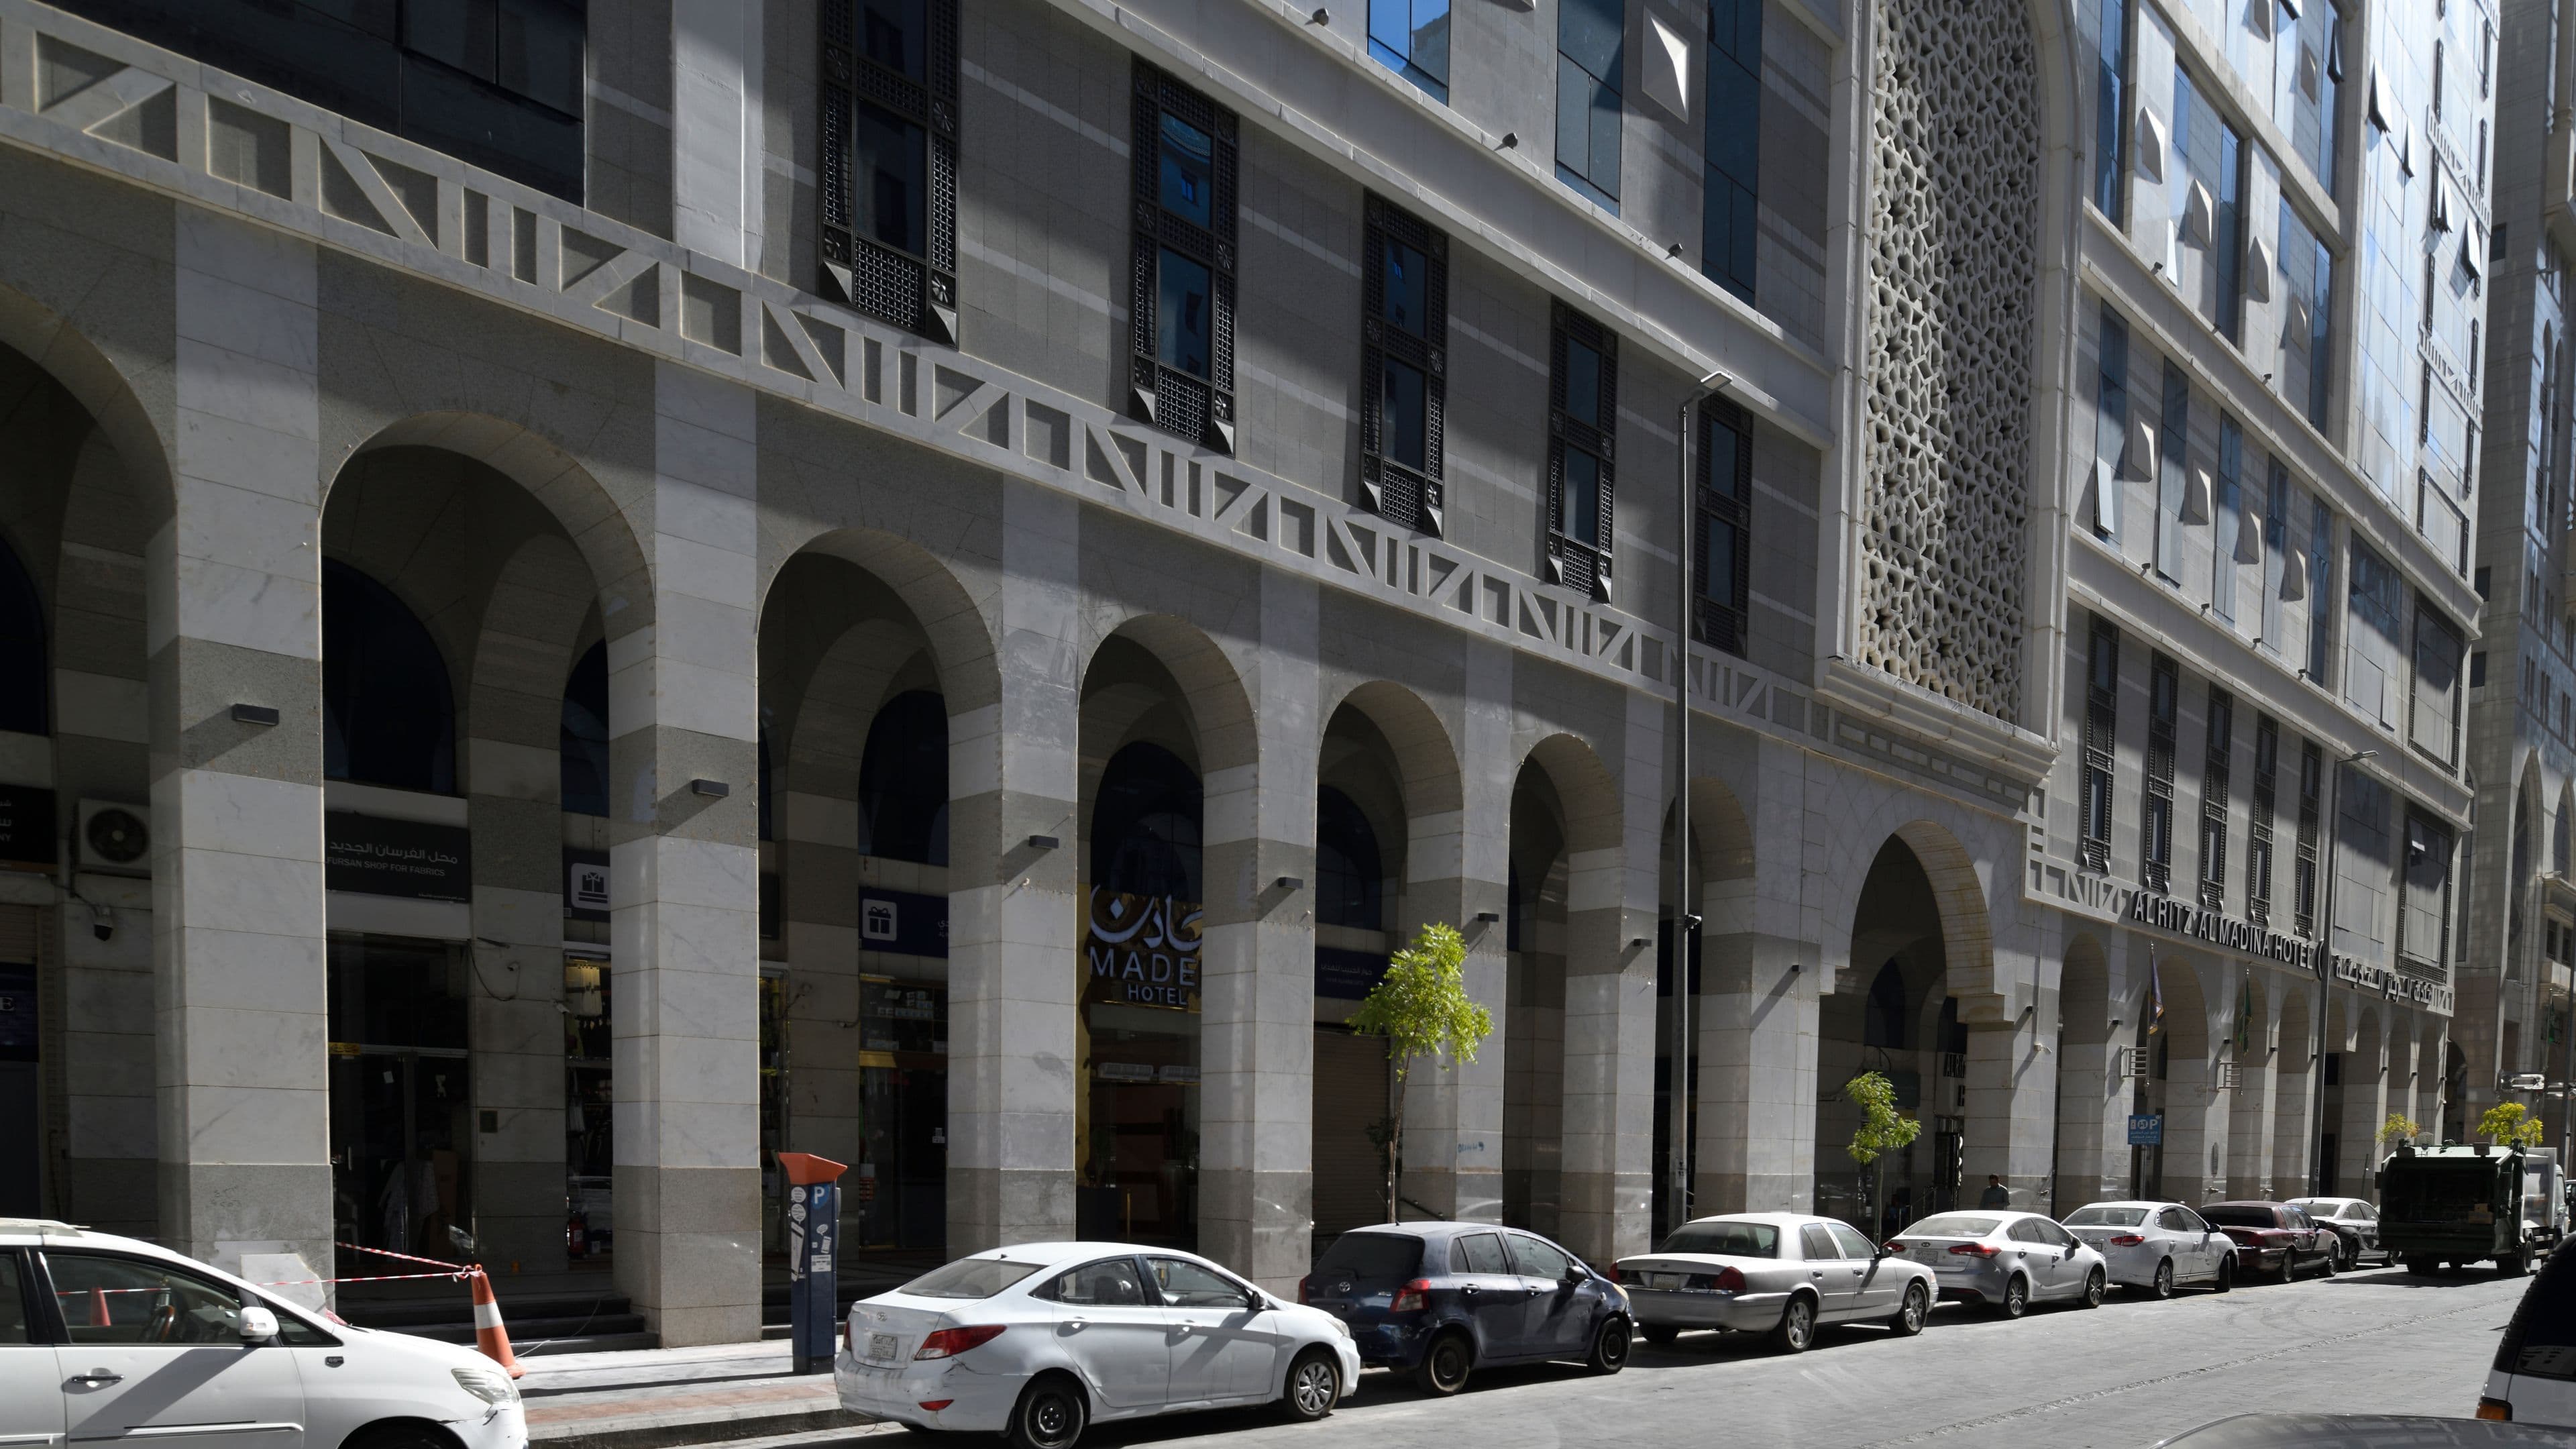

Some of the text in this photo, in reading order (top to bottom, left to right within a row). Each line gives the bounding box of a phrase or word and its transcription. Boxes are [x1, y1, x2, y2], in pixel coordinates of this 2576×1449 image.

[329, 841, 458, 865] محل الفرسان الجديد
[364, 861, 388, 870] SHOP
[390, 863, 408, 873] FOR
[410, 866, 445, 877] FABRICS
[2273, 934, 2315, 970] HOTEL
[1127, 983, 1187, 1005] HOTEL
[2149, 1119, 2158, 1130] P
[814, 1186, 825, 1204] P
